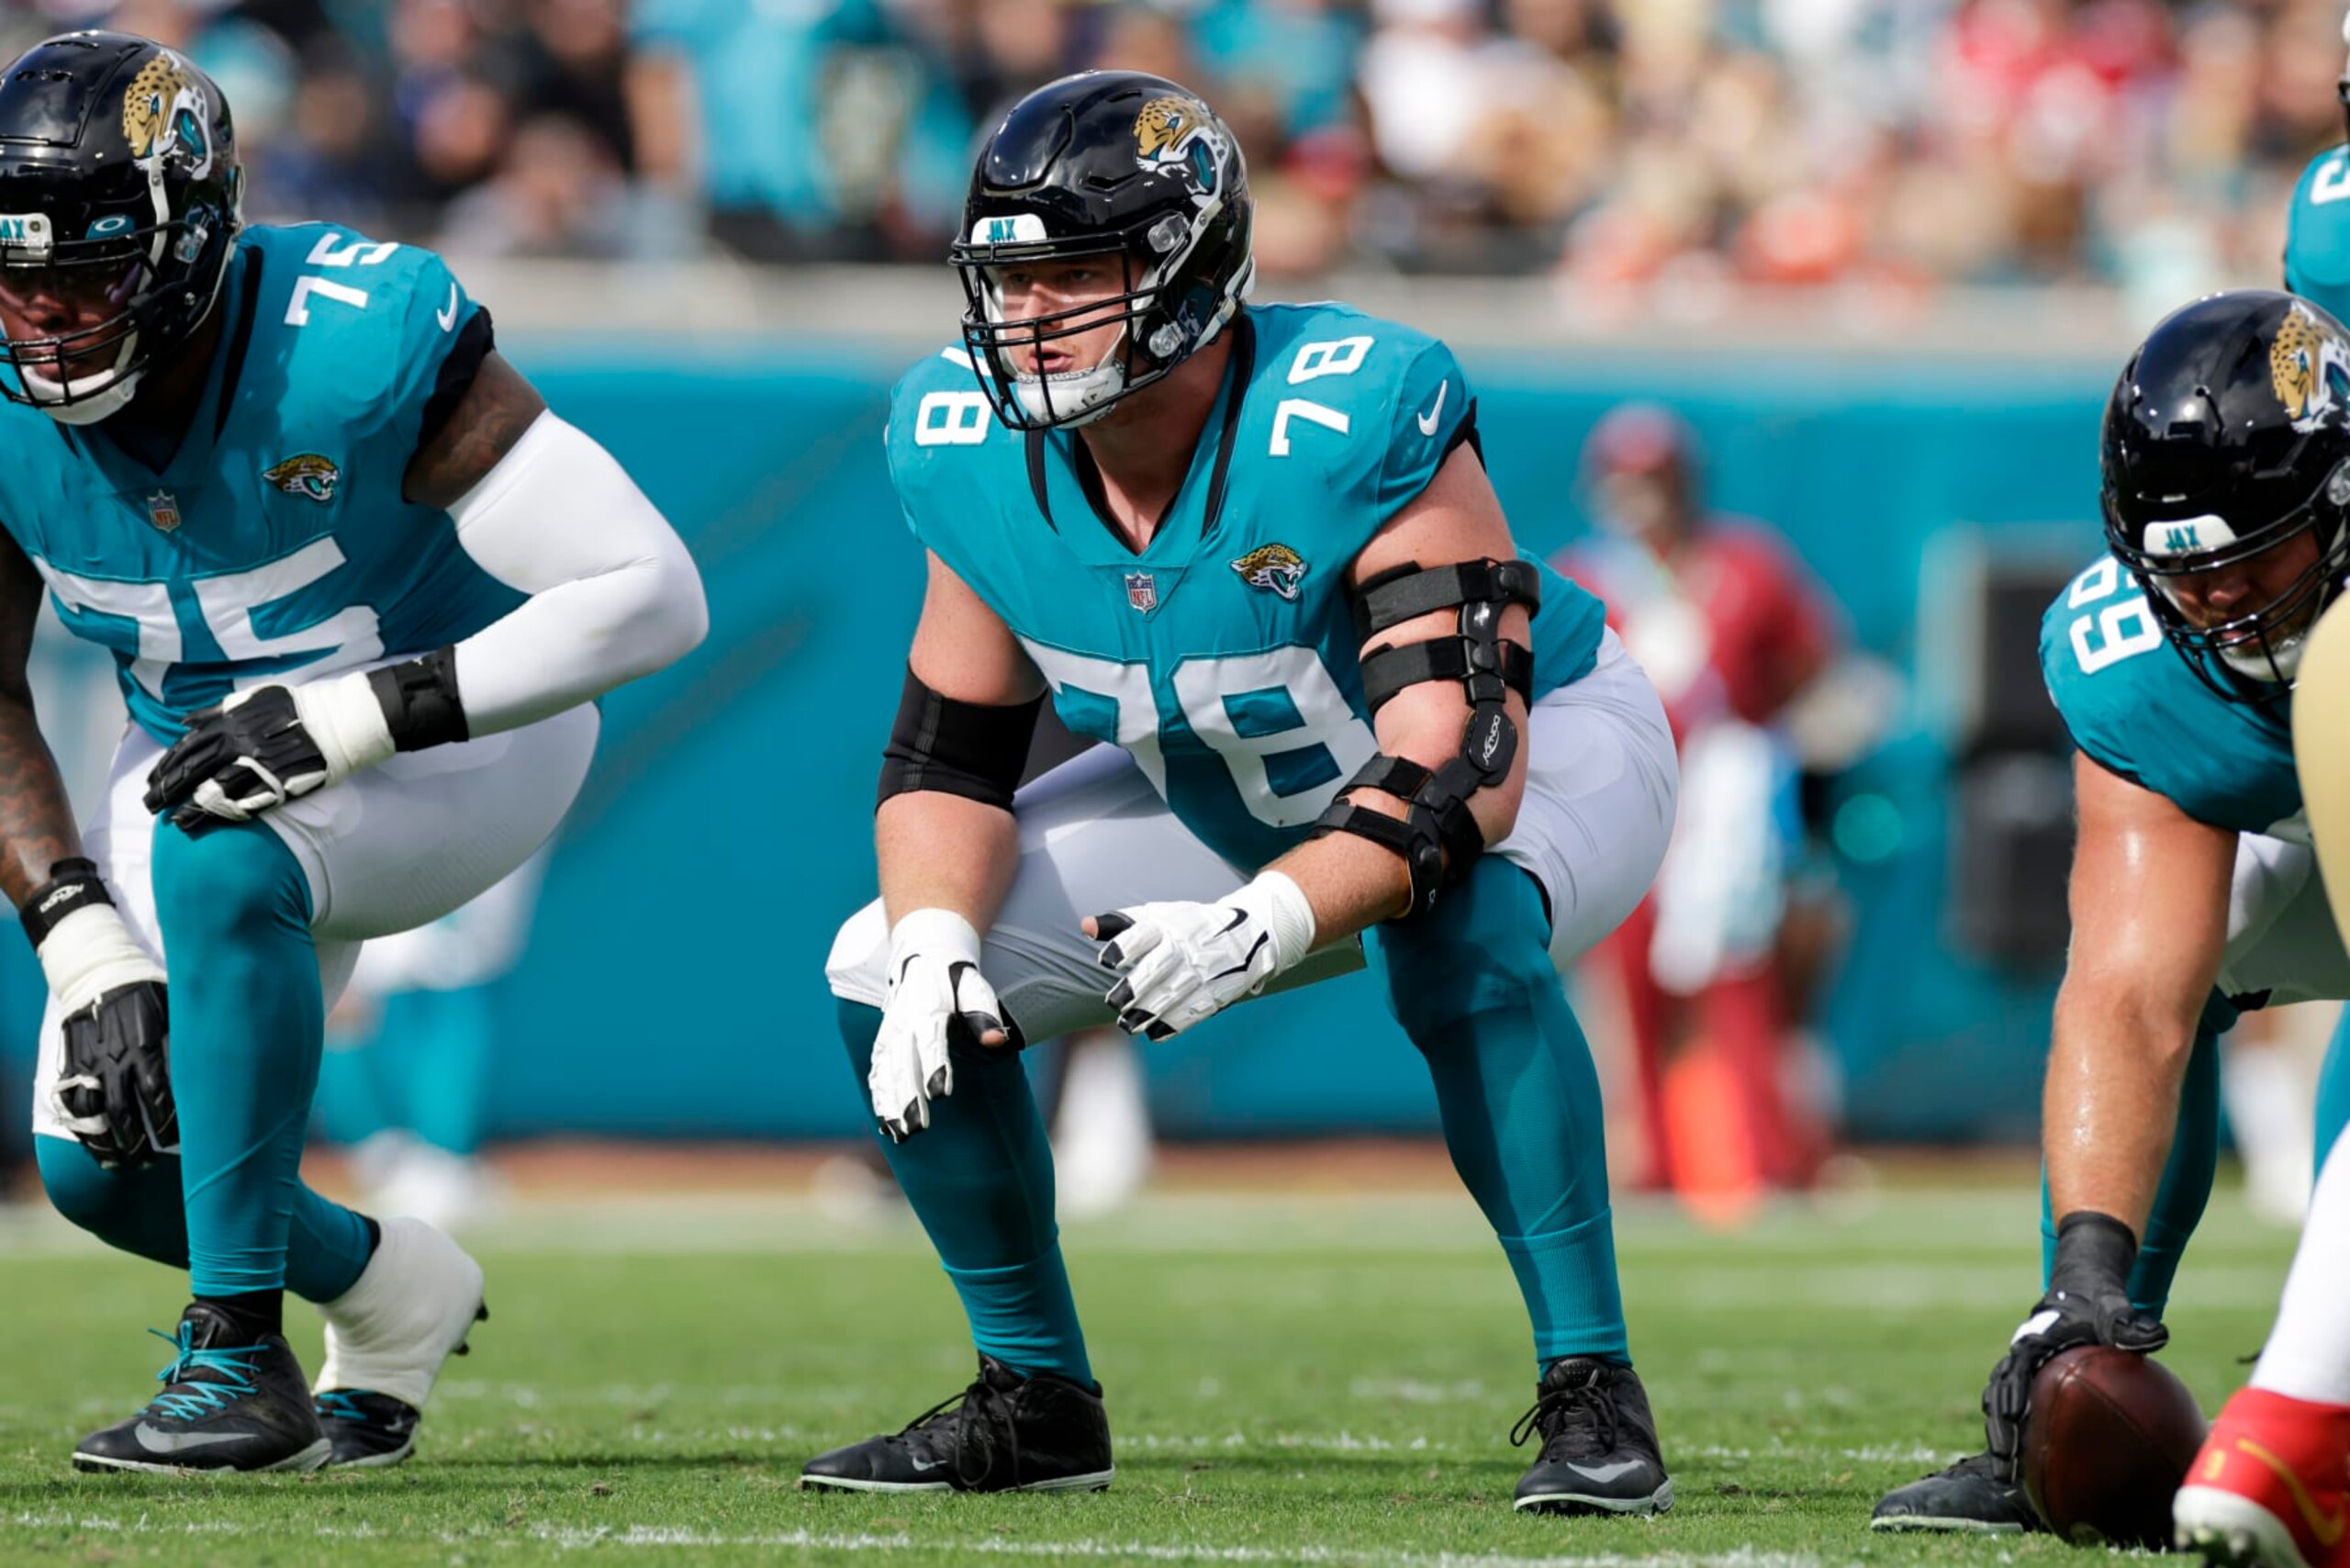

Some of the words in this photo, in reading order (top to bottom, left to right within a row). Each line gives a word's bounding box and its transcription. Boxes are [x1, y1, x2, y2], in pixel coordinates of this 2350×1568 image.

[0, 218, 26, 241] AX
[283, 232, 400, 326] 75
[986, 218, 1017, 241] JAX
[1269, 335, 1375, 456] 78
[2165, 525, 2201, 551] JAX
[32, 536, 385, 703] 75
[2067, 555, 2164, 676] 69
[1014, 637, 1379, 828] 78
